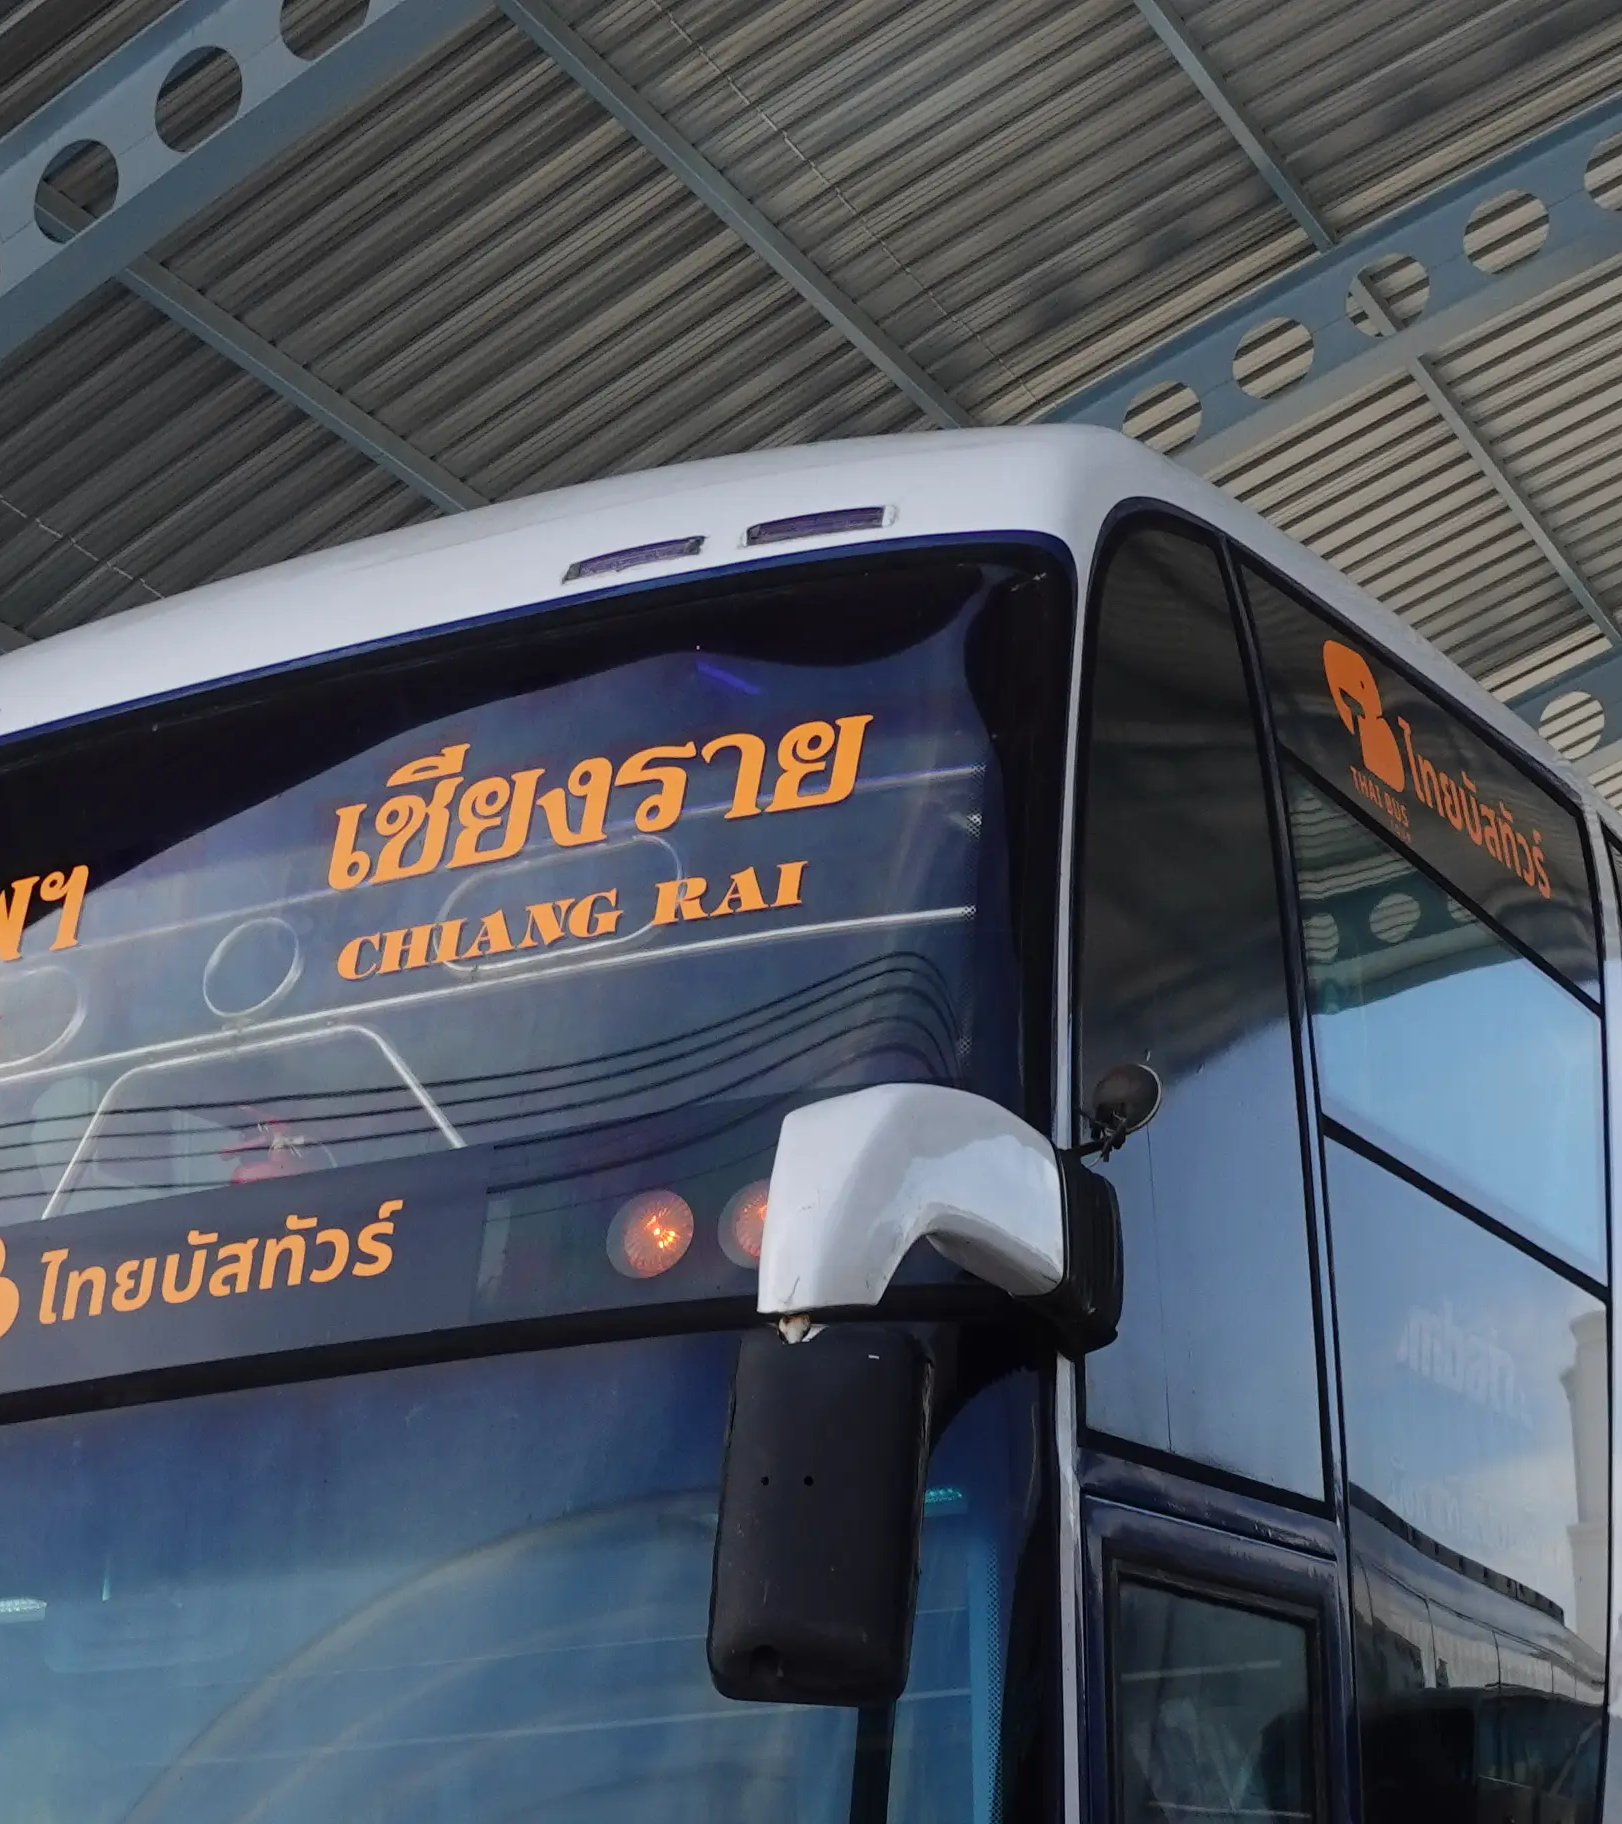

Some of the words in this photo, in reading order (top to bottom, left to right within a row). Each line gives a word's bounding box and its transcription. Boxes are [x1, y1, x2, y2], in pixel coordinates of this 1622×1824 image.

[327, 714, 874, 892] เชียงราย
[1398, 716, 1552, 900] ไทยบัสทัวร์
[337, 886, 622, 981] CHIANG
[651, 860, 809, 926] RAI
[38, 1199, 405, 1326] ไทยบัสทัวร์
